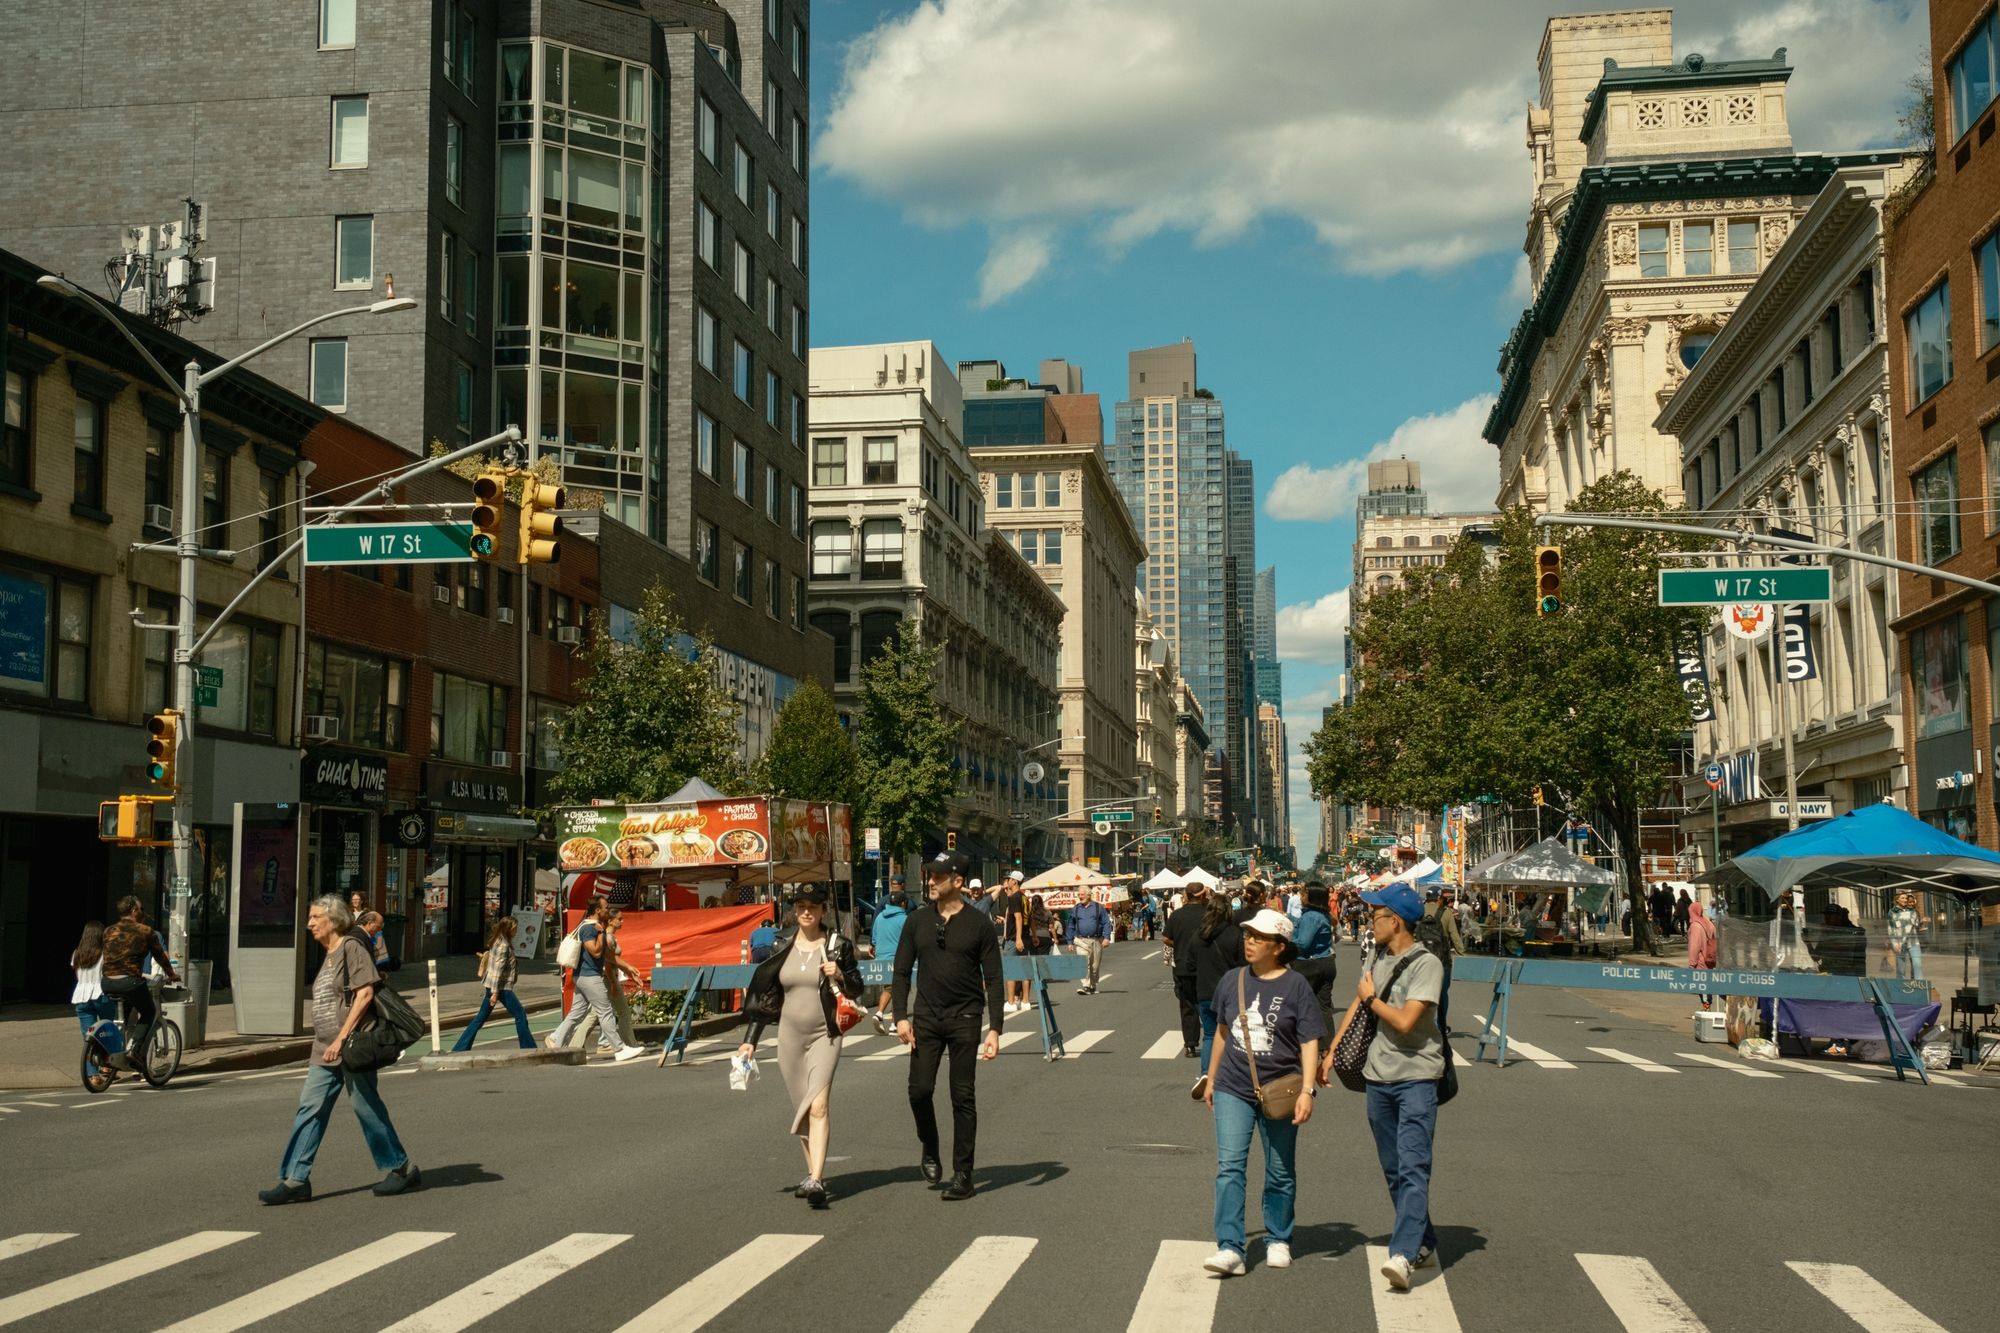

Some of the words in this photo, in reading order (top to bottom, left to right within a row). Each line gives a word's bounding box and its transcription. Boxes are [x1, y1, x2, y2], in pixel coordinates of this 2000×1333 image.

[359, 536, 372, 555] W
[380, 535, 396, 554] 17
[403, 534, 421, 554] St
[1714, 579, 1728, 597] W
[1736, 578, 1752, 596] 17
[1759, 578, 1777, 596] St
[0, 589, 24, 605] pace
[317, 759, 350, 786] GUAC
[361, 766, 387, 790] TIME
[451, 781, 469, 798] ALSA
[472, 783, 486, 800] NAIL
[489, 785, 494, 799] &
[497, 786, 508, 801] SPA
[570, 811, 599, 819] CHICKEN
[724, 803, 756, 814] FAJITAS
[1800, 804, 1827, 814] NAVY
[731, 812, 758, 821] CHORIZO
[572, 825, 597, 834] STEAK
[619, 817, 649, 837] Taco
[652, 813, 707, 836] Callejero
[1602, 967, 1640, 979] POLICE
[1650, 969, 1674, 981] LINE
[1693, 971, 1707, 982] DO
[1712, 972, 1734, 984] NOT
[1738, 973, 1776, 985] CROSS
[1669, 982, 1707, 991] NYPD
[1269, 996, 1285, 1011] U.S.
